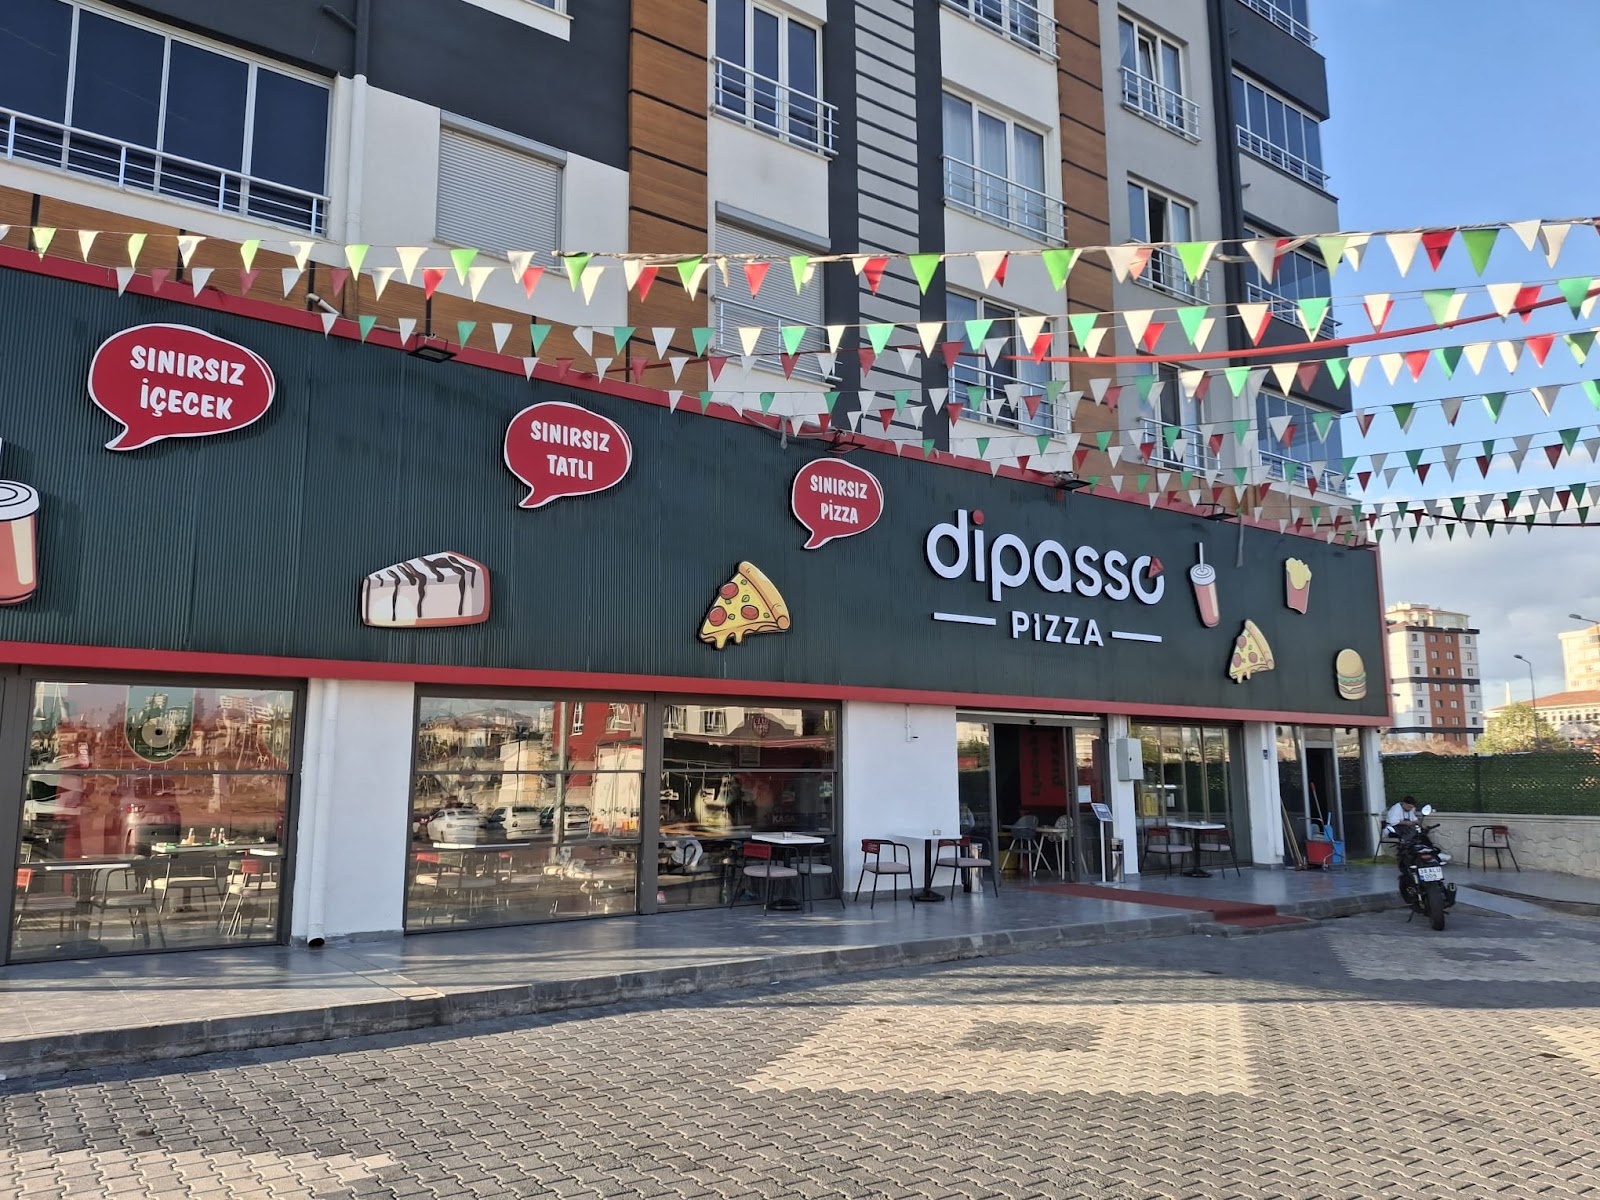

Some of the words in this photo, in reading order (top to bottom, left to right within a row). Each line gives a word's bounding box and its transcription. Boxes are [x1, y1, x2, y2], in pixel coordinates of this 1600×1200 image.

[129, 344, 246, 387] SINIRSIZ
[139, 377, 233, 420] İÇECEK
[530, 420, 611, 453] SINIRSIZ
[546, 454, 594, 481] TATLI
[810, 474, 868, 500] SINIRSIZ
[820, 499, 859, 525] PİZZA
[926, 508, 1165, 605] dipasso
[1011, 610, 1104, 647] PIZZA
